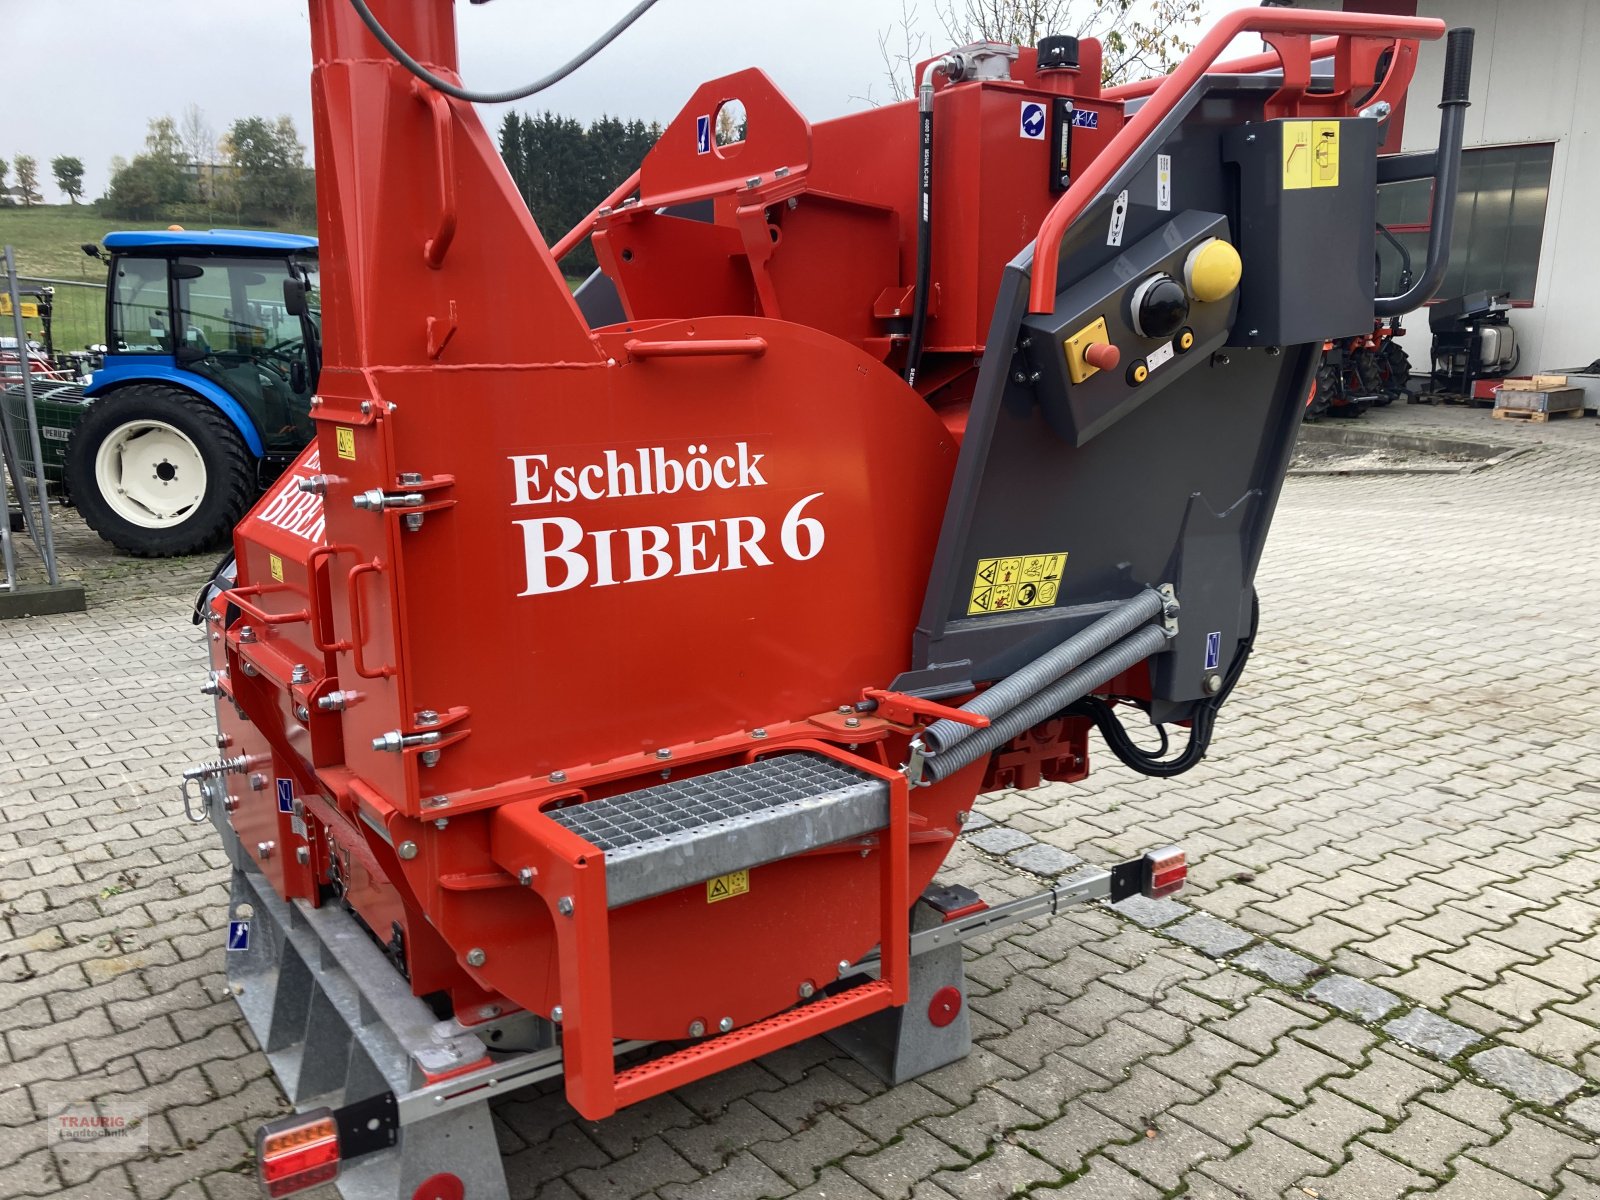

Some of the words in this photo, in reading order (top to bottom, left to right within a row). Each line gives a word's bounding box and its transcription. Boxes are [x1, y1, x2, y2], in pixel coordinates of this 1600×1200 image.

[507, 441, 768, 507] Eschlböck
[512, 515, 774, 597] BIBER
[780, 492, 826, 561] 6
